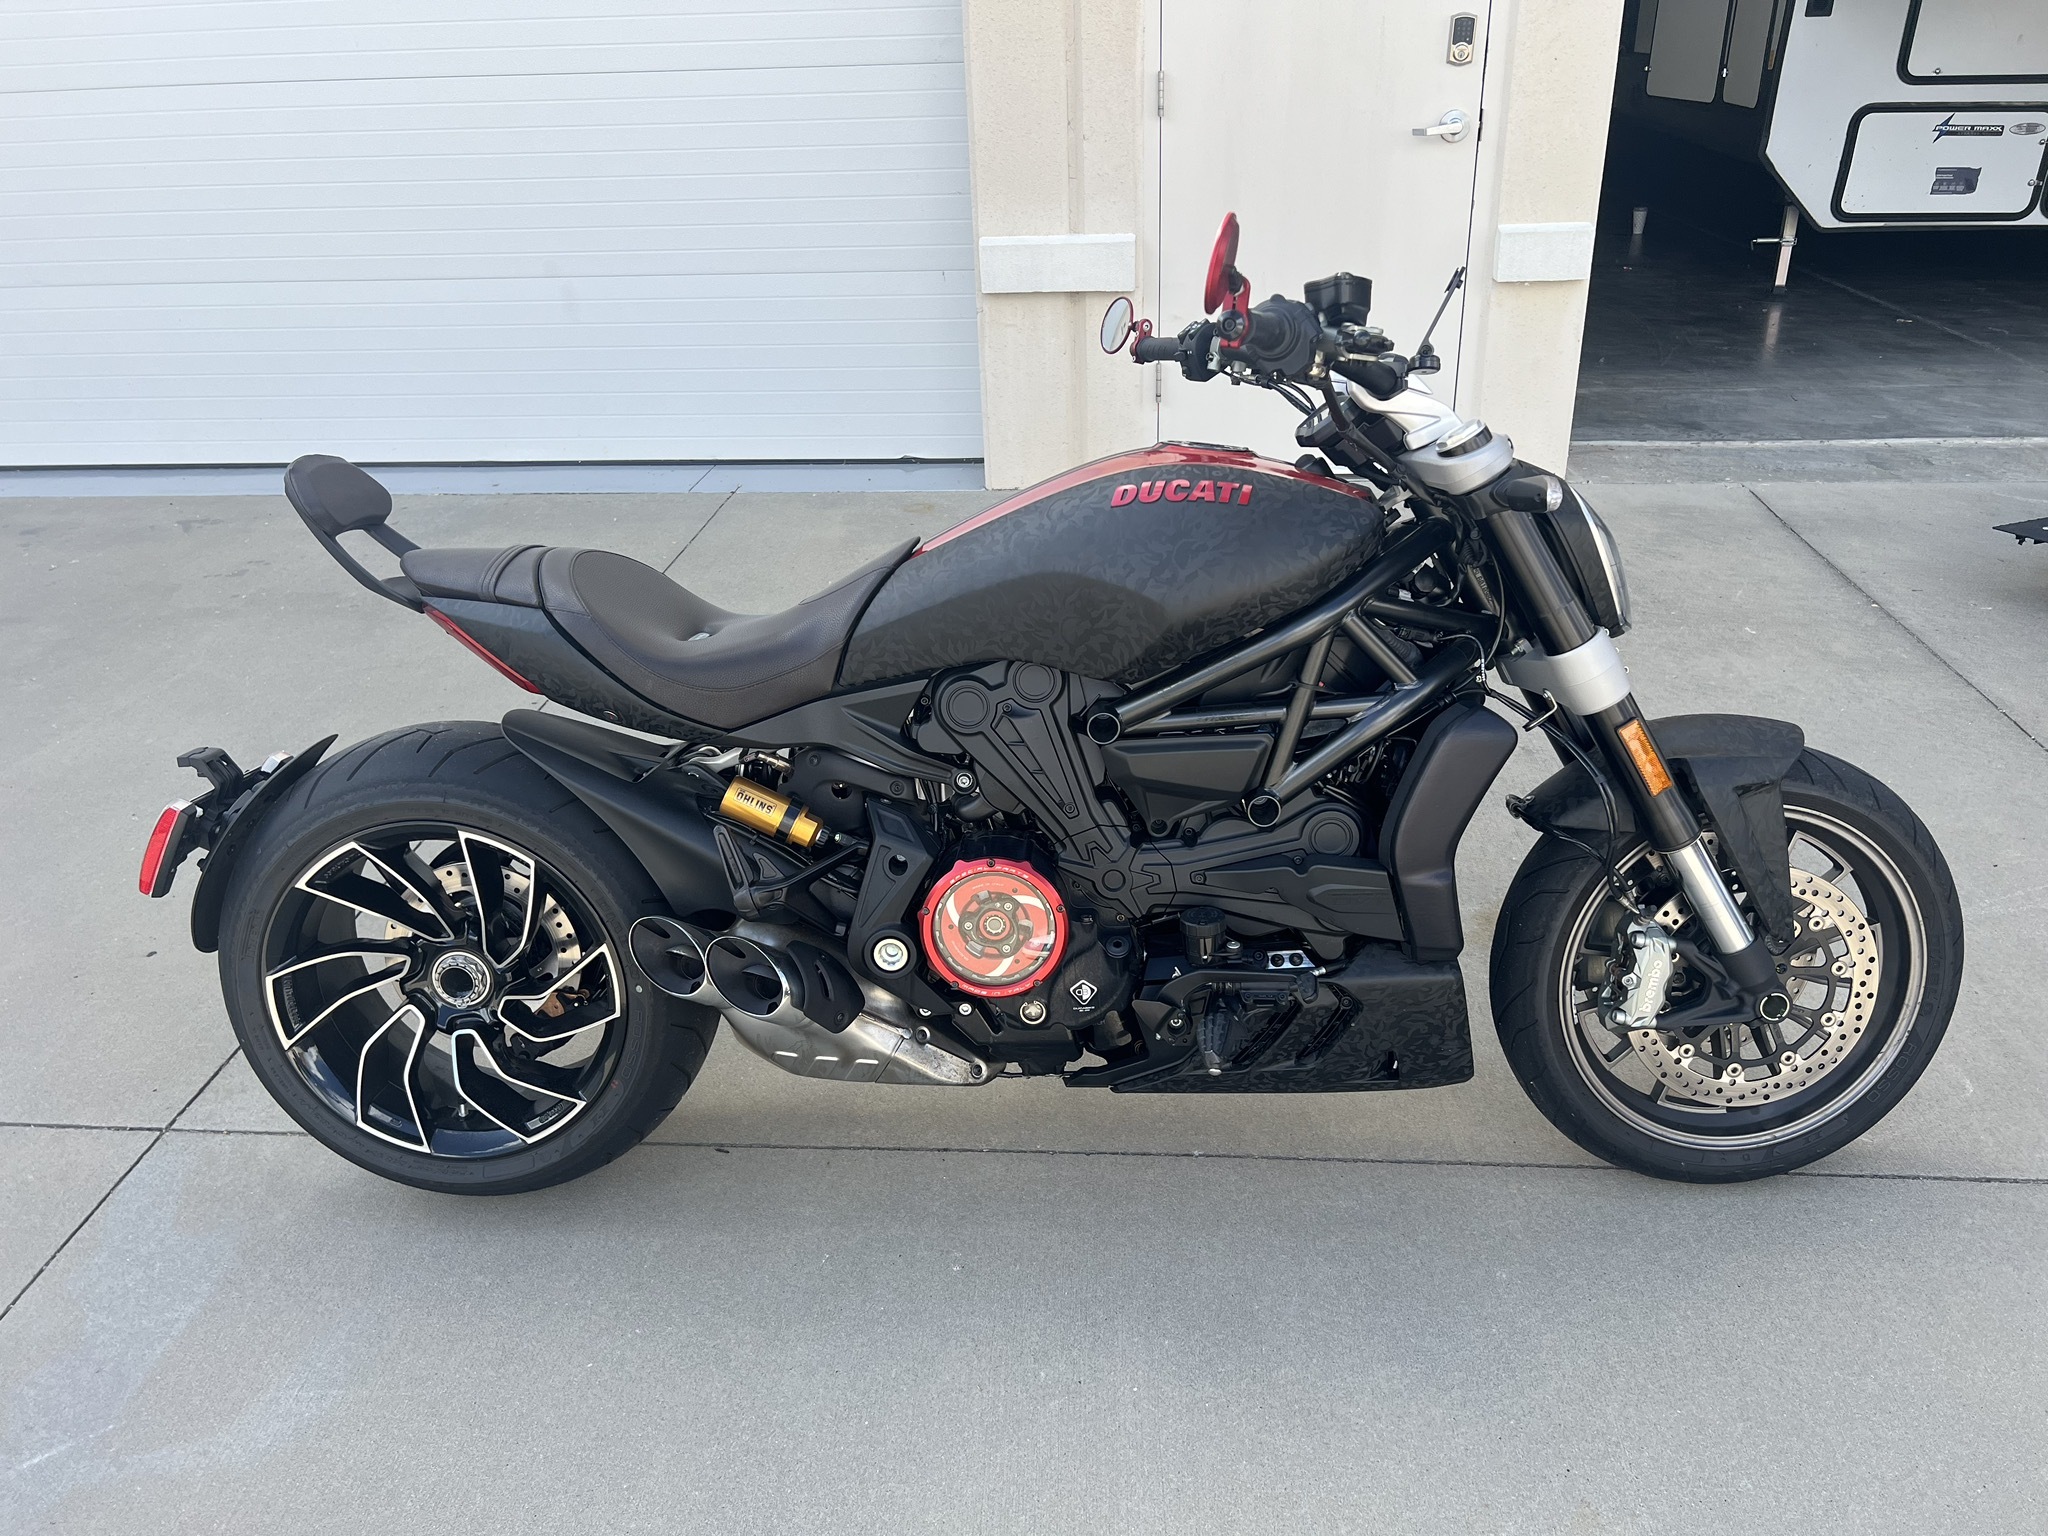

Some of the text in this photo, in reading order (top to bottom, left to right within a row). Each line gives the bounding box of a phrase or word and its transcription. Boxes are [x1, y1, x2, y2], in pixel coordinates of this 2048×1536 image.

[1110, 479, 1253, 508] DUCATI
[1639, 959, 1663, 1013] brembo
[621, 1009, 643, 1080] ROSSO
[1866, 1042, 1918, 1103] ROSSO
